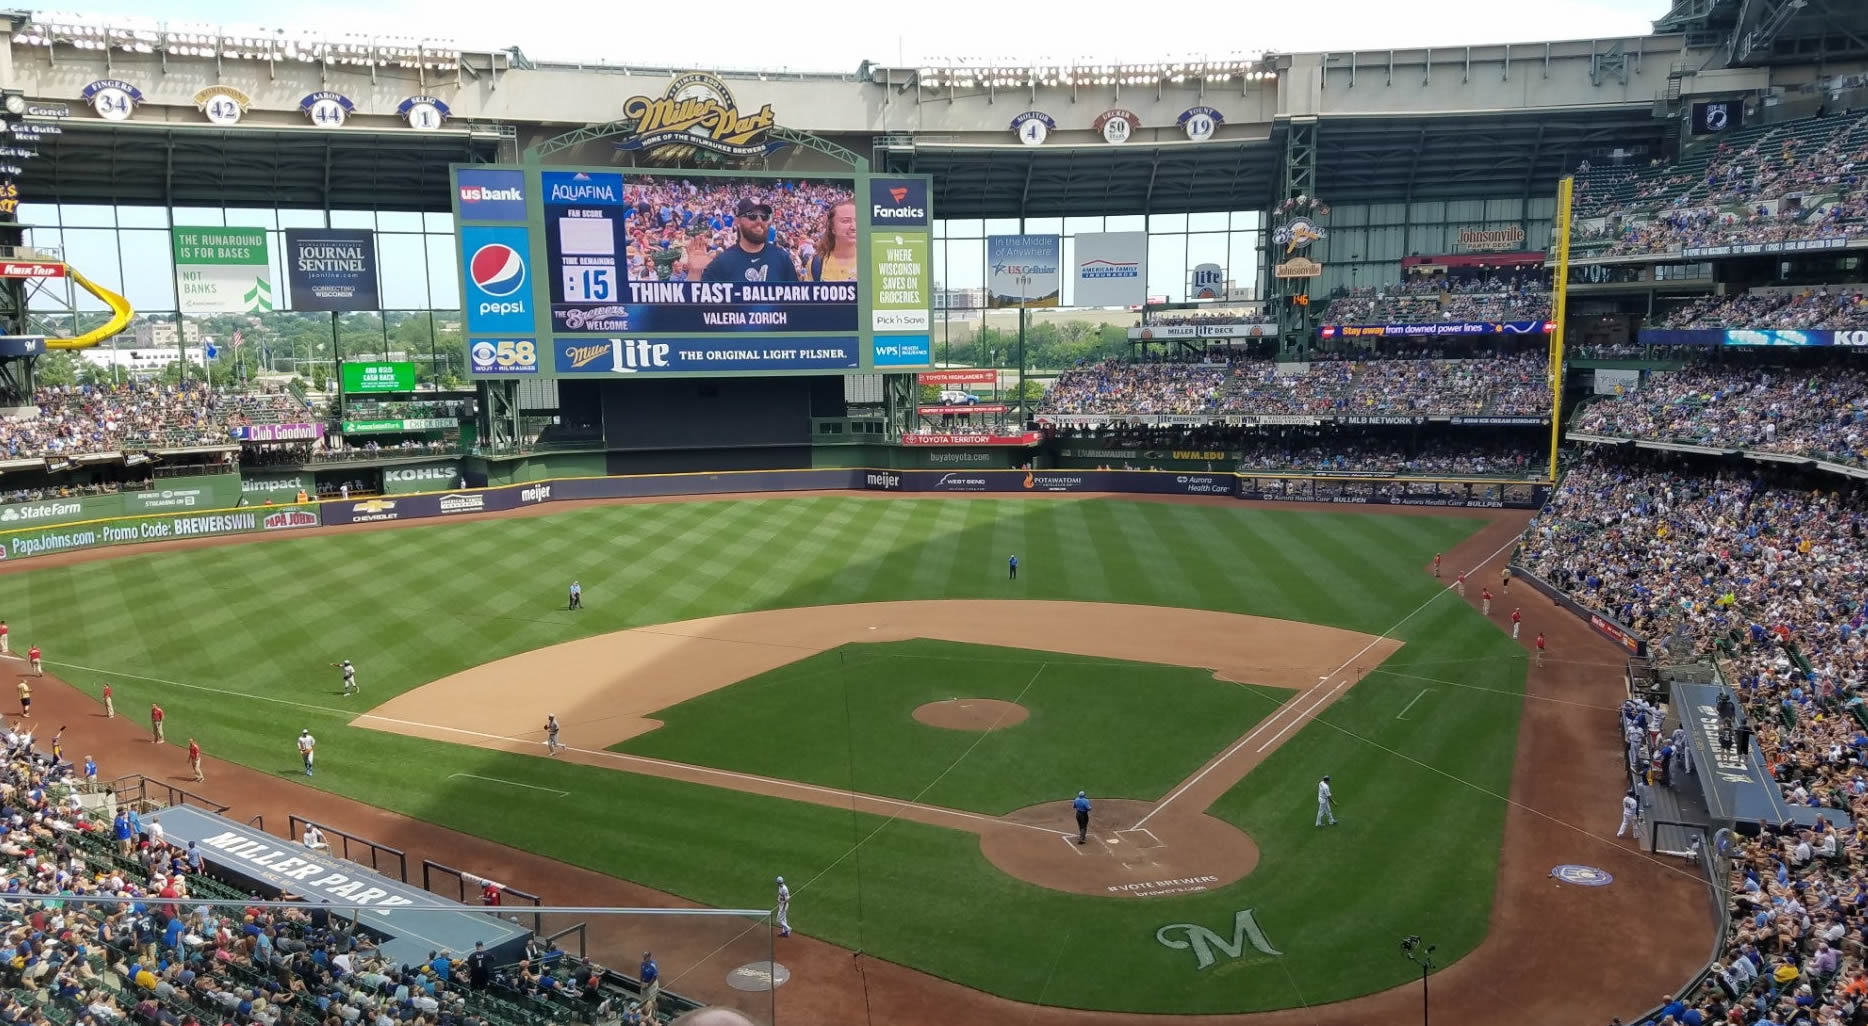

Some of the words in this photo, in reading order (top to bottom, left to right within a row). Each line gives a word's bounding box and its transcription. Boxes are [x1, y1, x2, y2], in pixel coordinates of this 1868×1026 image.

[91, 79, 133, 92] FINGERS
[675, 75, 700, 89] SINCE
[101, 95, 128, 113] 34
[312, 94, 341, 102] AARON
[28, 106, 69, 116] Gone!
[210, 101, 238, 118] 42
[315, 106, 341, 122] 44
[1102, 110, 1130, 120] UECKER
[1189, 107, 1213, 116] YOUNT
[420, 111, 431, 127] 1
[624, 96, 719, 136] Miller
[701, 104, 775, 144] Park
[1018, 111, 1048, 122] MOLITOR
[10, 124, 28, 132] Get
[31, 125, 62, 133] Outta
[1027, 125, 1036, 139] 4
[1109, 121, 1125, 134] 50
[1191, 119, 1210, 135] 19
[642, 133, 661, 146] HOME
[662, 133, 672, 141] OF
[674, 133, 689, 141] THE
[551, 184, 616, 201] AQUAFINA
[874, 205, 924, 218] Fanatics
[179, 234, 198, 245] THE
[202, 234, 263, 246] RUNAROUND
[995, 237, 1004, 246] In
[1005, 237, 1020, 246] the
[1022, 236, 1053, 246] Middle
[1457, 225, 1525, 244] Johnsonville
[180, 248, 191, 258] IS
[195, 248, 215, 258] FOR
[218, 248, 251, 259] BASES
[298, 246, 365, 260] JOURNAL
[886, 249, 912, 262] WHERE
[995, 248, 1005, 257] of
[4, 264, 32, 275] KWIK
[33, 264, 56, 275] TRIP
[298, 259, 366, 272] SENTINEL
[879, 263, 920, 276] WISCONSIN
[1277, 265, 1320, 275] Johnsonville
[183, 271, 202, 281] NOT
[1195, 270, 1220, 287] Lite
[184, 283, 217, 294] BANKS
[882, 277, 905, 289] SAVES
[907, 277, 918, 289] ON
[629, 282, 686, 303] THINK
[813, 285, 856, 301] FOODS
[480, 300, 525, 316] pepsi
[565, 305, 629, 329] Brewers
[703, 311, 746, 325] VALERIA
[748, 311, 787, 325] ZORICH
[877, 315, 894, 324] Pick
[904, 316, 925, 324] Save
[586, 320, 629, 331] WELCOME
[1343, 326, 1361, 336] Stay
[1362, 327, 1385, 336] away
[1386, 325, 1403, 334] from
[1405, 324, 1437, 334] downed
[1437, 324, 1461, 334] power
[1463, 323, 1483, 332] lines
[496, 341, 536, 367] 58
[565, 344, 611, 368] Miller
[609, 338, 670, 373] Lite
[679, 351, 703, 361] THE
[706, 350, 760, 360] ORIGINAL
[763, 349, 797, 360] LIGHT
[876, 346, 898, 356] WPS
[1349, 416, 1365, 424] MLB
[1368, 416, 1412, 424] NETWORK
[251, 425, 271, 440] Club
[275, 423, 316, 439] Goodwill
[918, 436, 949, 444] TOYOTA
[950, 435, 990, 444] TERRITORY
[930, 452, 990, 463] buyatoyota.com
[1173, 450, 1225, 460] UWM.EDU
[385, 466, 457, 482] KOHL'S
[867, 471, 900, 489] meijer
[250, 477, 302, 492] impact
[1188, 484, 1210, 492] Health
[521, 484, 550, 502] meijer
[265, 514, 287, 527] PAPA
[353, 513, 398, 522] CHEVROLET
[13, 532, 95, 556] PapaJohns.com
[103, 524, 138, 543] Promo
[141, 522, 172, 537] Code:
[174, 514, 255, 535] BREWERSWIN
[201, 831, 325, 880] MILLER
[309, 872, 413, 915] PARK
[1107, 880, 1152, 893] #VOTE
[1156, 875, 1219, 888] BREWERS
[1136, 885, 1207, 898] brewers.com
